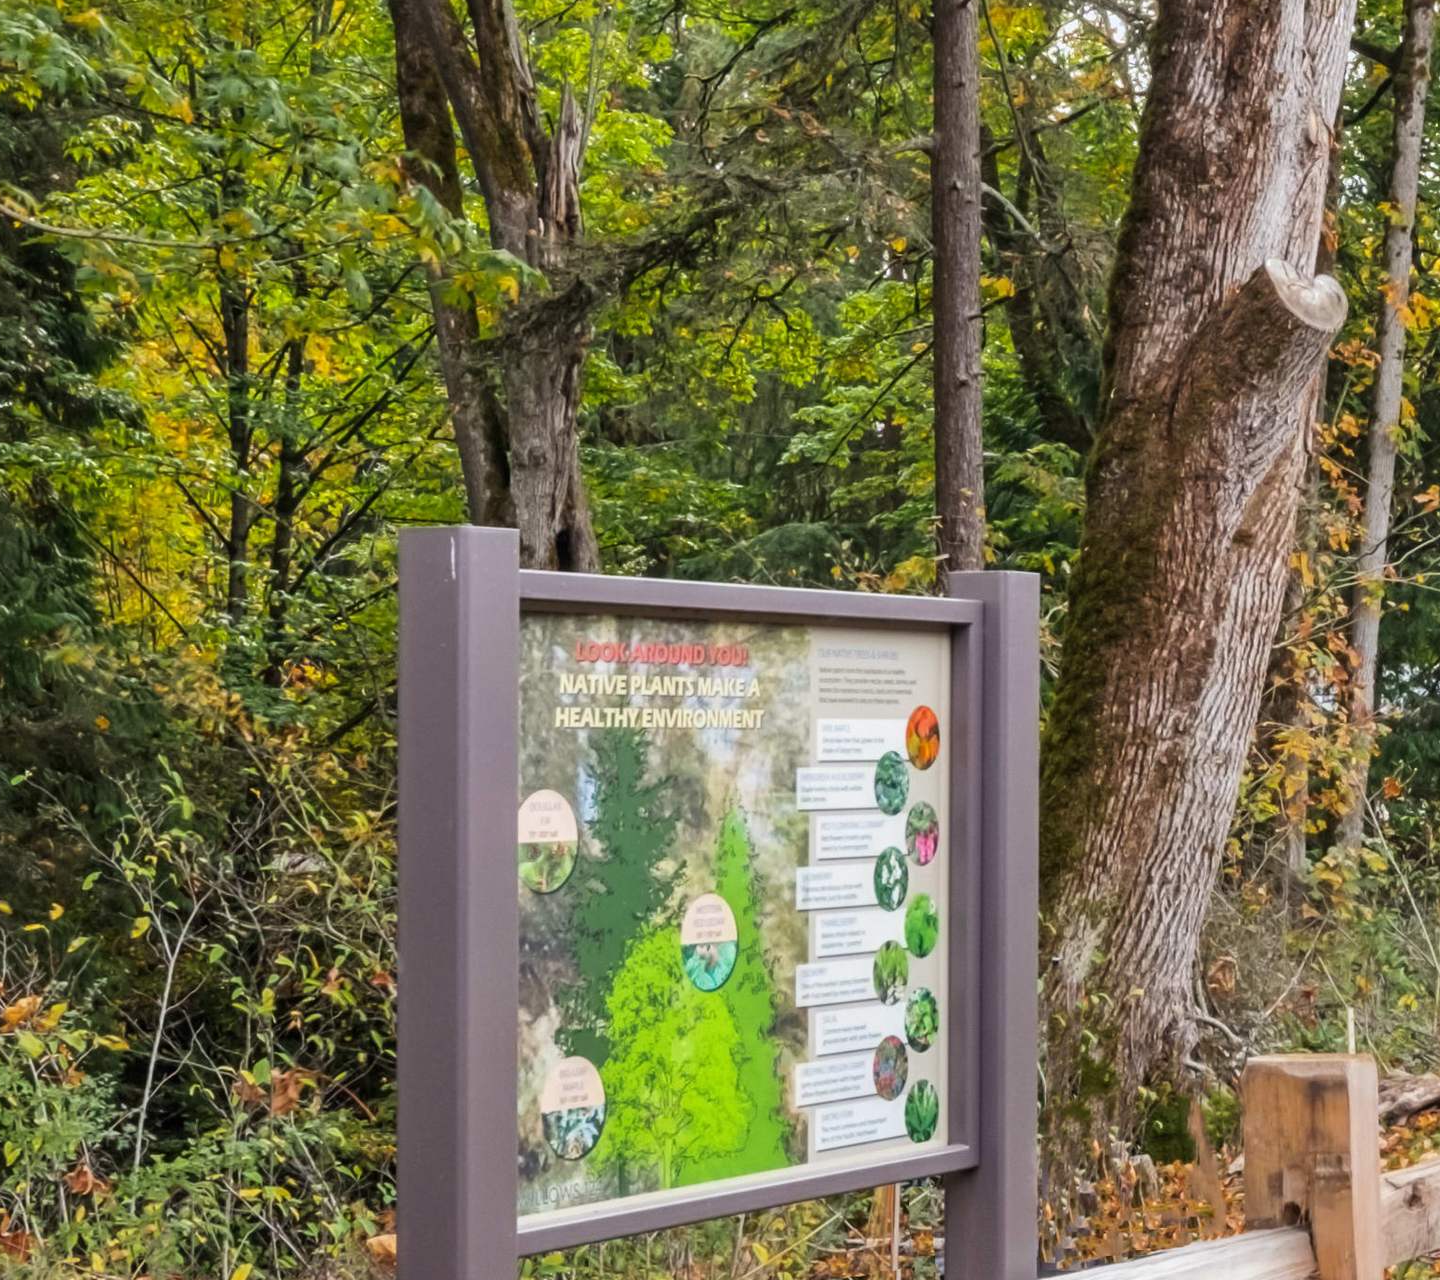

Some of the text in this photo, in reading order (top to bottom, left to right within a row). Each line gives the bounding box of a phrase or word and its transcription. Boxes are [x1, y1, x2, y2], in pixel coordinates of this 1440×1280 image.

[576, 640, 749, 666] LOOK AROUND YOU!
[560, 674, 761, 697] NATIVE PLANTS MAKE A
[555, 706, 765, 729] HEALTHY ENVIRONMENT
